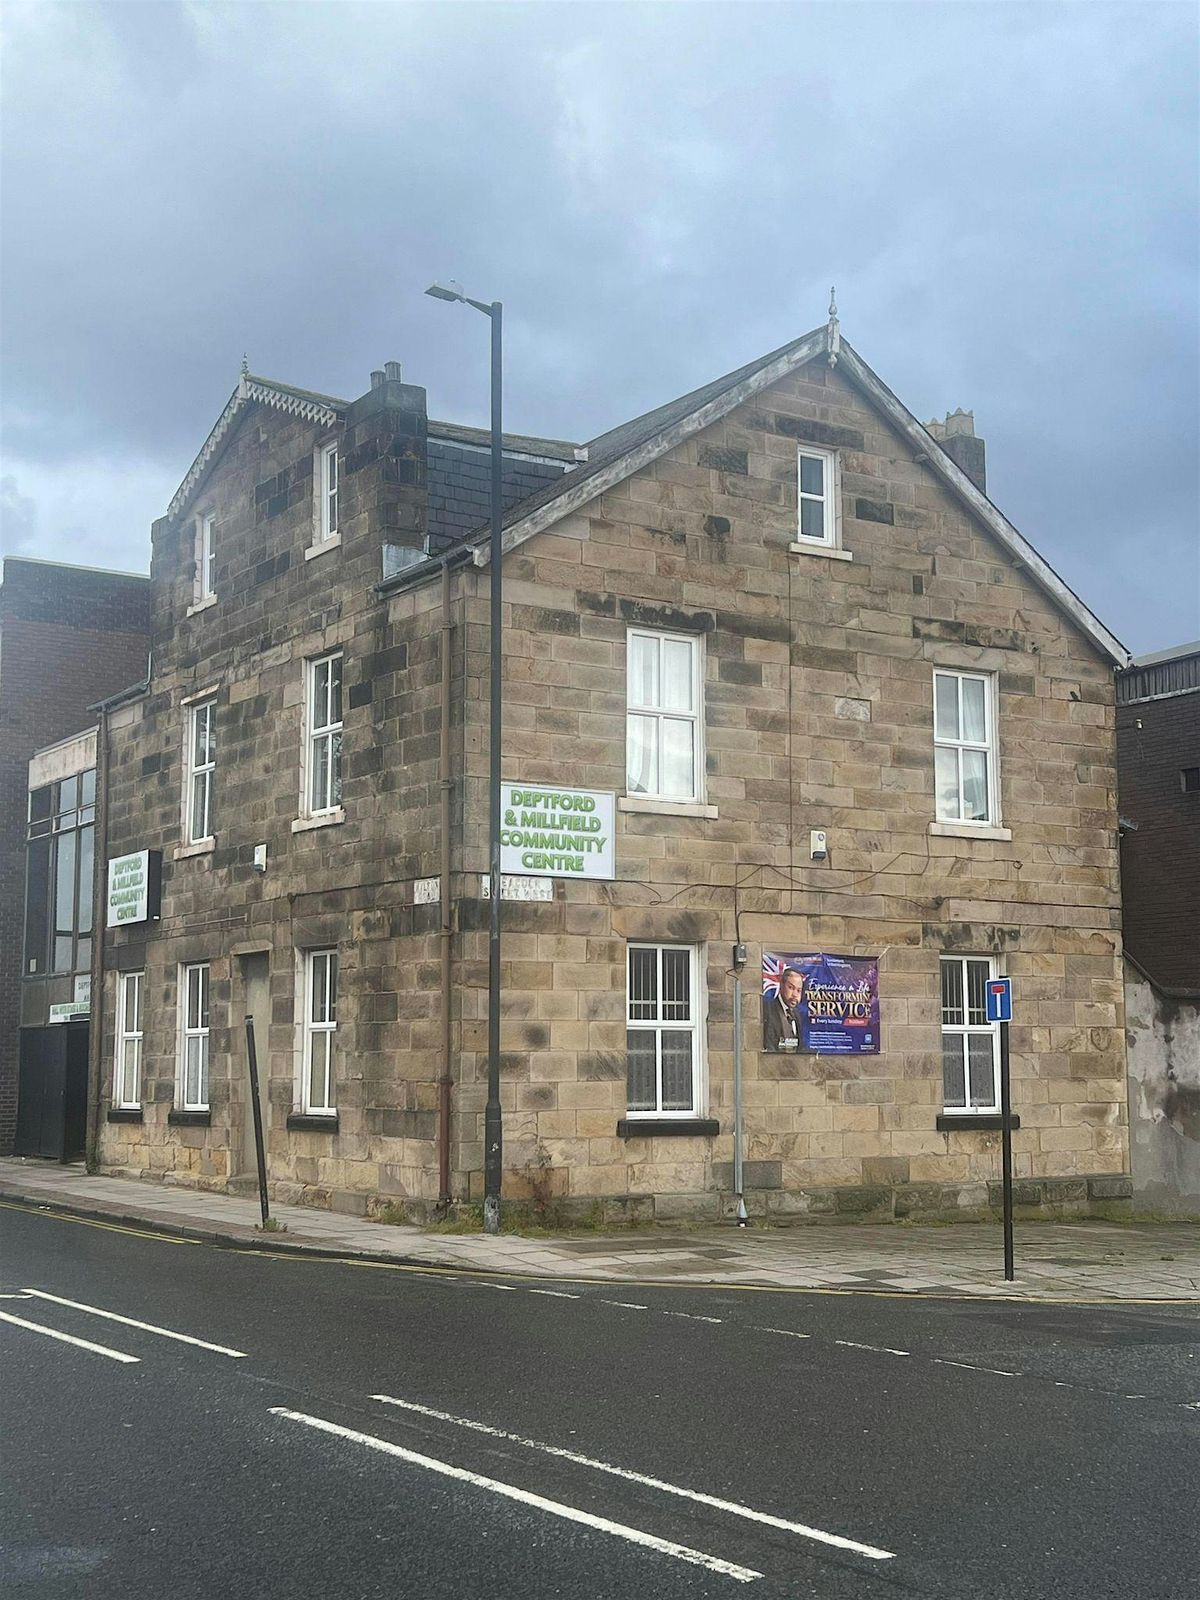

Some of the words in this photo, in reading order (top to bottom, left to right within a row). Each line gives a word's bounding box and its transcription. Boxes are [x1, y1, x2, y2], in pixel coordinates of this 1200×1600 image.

[510, 789, 596, 812] DEPTFORD
[504, 809, 518, 827] &
[520, 810, 602, 833] MILLFIELD
[500, 829, 607, 853] COMMUNITY
[521, 852, 585, 872] CENTRE
[117, 904, 137, 920] CENTRE
[808, 1001, 872, 1018] SERVICE
